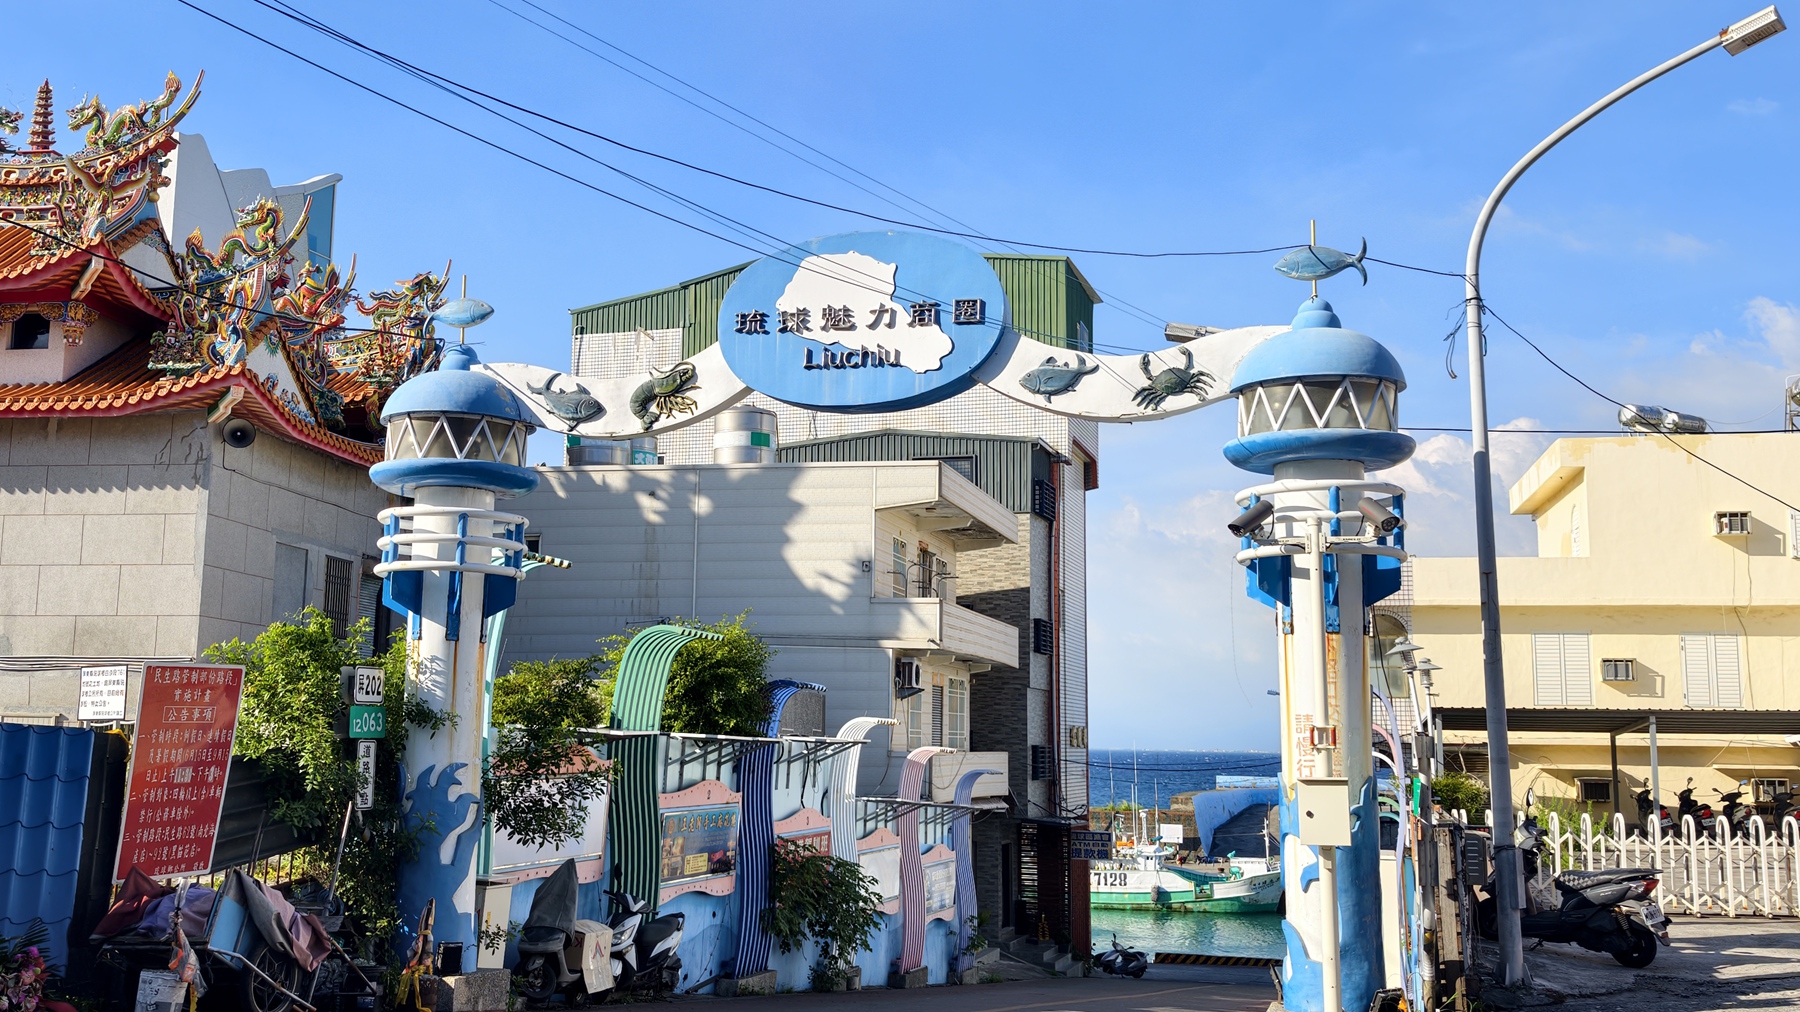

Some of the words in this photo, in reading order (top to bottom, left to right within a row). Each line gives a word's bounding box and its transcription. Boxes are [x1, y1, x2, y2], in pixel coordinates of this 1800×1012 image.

[734, 299, 984, 333] 琉球魅力商圈
[803, 344, 901, 370] Liuchiu
[173, 688, 213, 702] 實施計畫
[358, 674, 382, 696] 屏202
[167, 707, 213, 721] 公告事項
[353, 712, 383, 733] 12.063
[359, 744, 372, 806] 道路點
[1090, 872, 1127, 887] 7128
